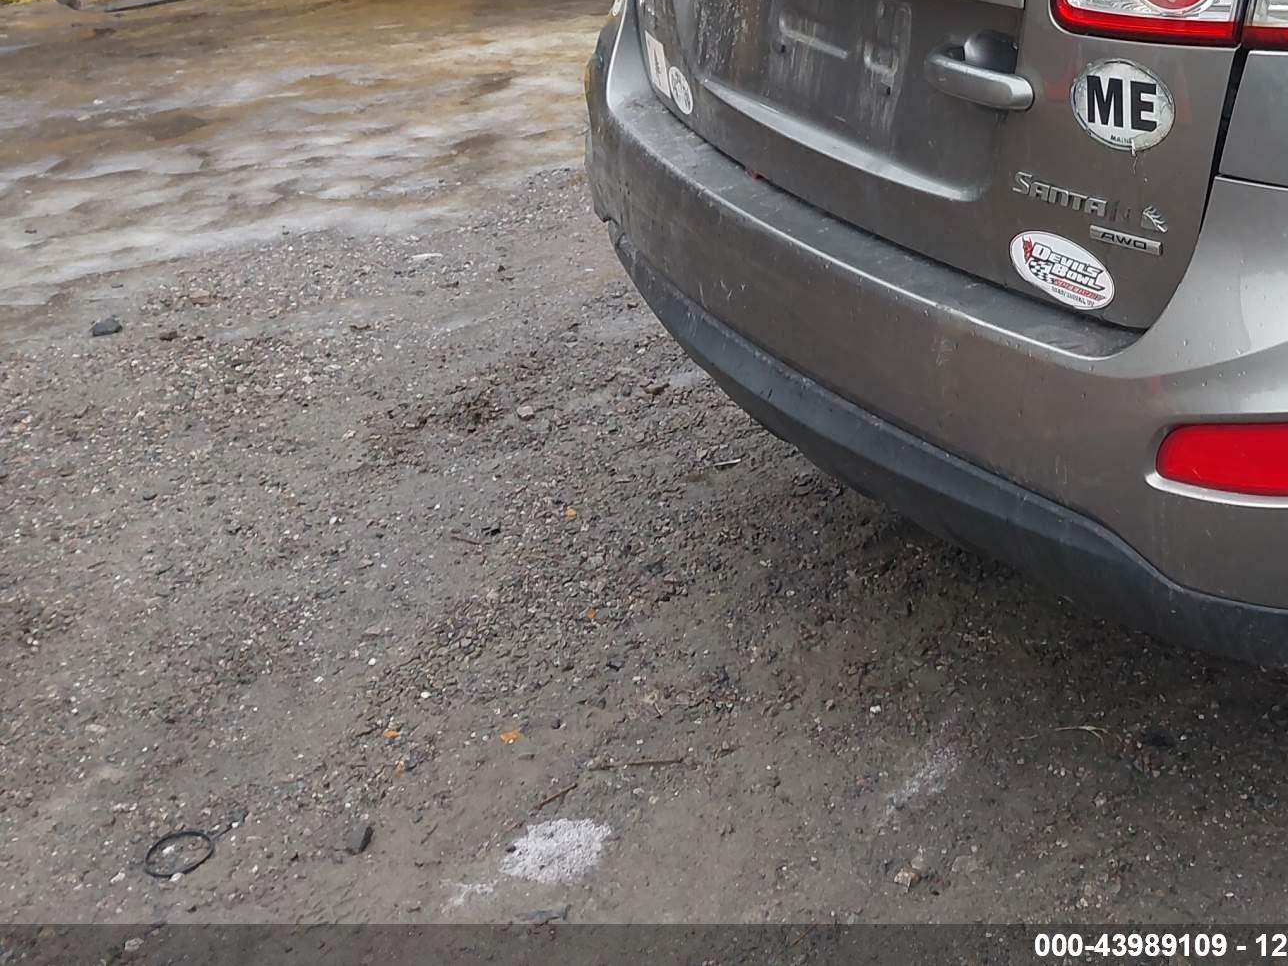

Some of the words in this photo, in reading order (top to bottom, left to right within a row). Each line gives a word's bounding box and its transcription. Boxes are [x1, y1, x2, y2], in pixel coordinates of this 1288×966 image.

[1086, 75, 1157, 132] ME
[1012, 171, 1108, 217] SANTA
[1100, 232, 1147, 251] AWD
[1050, 263, 1105, 291] BOWL
